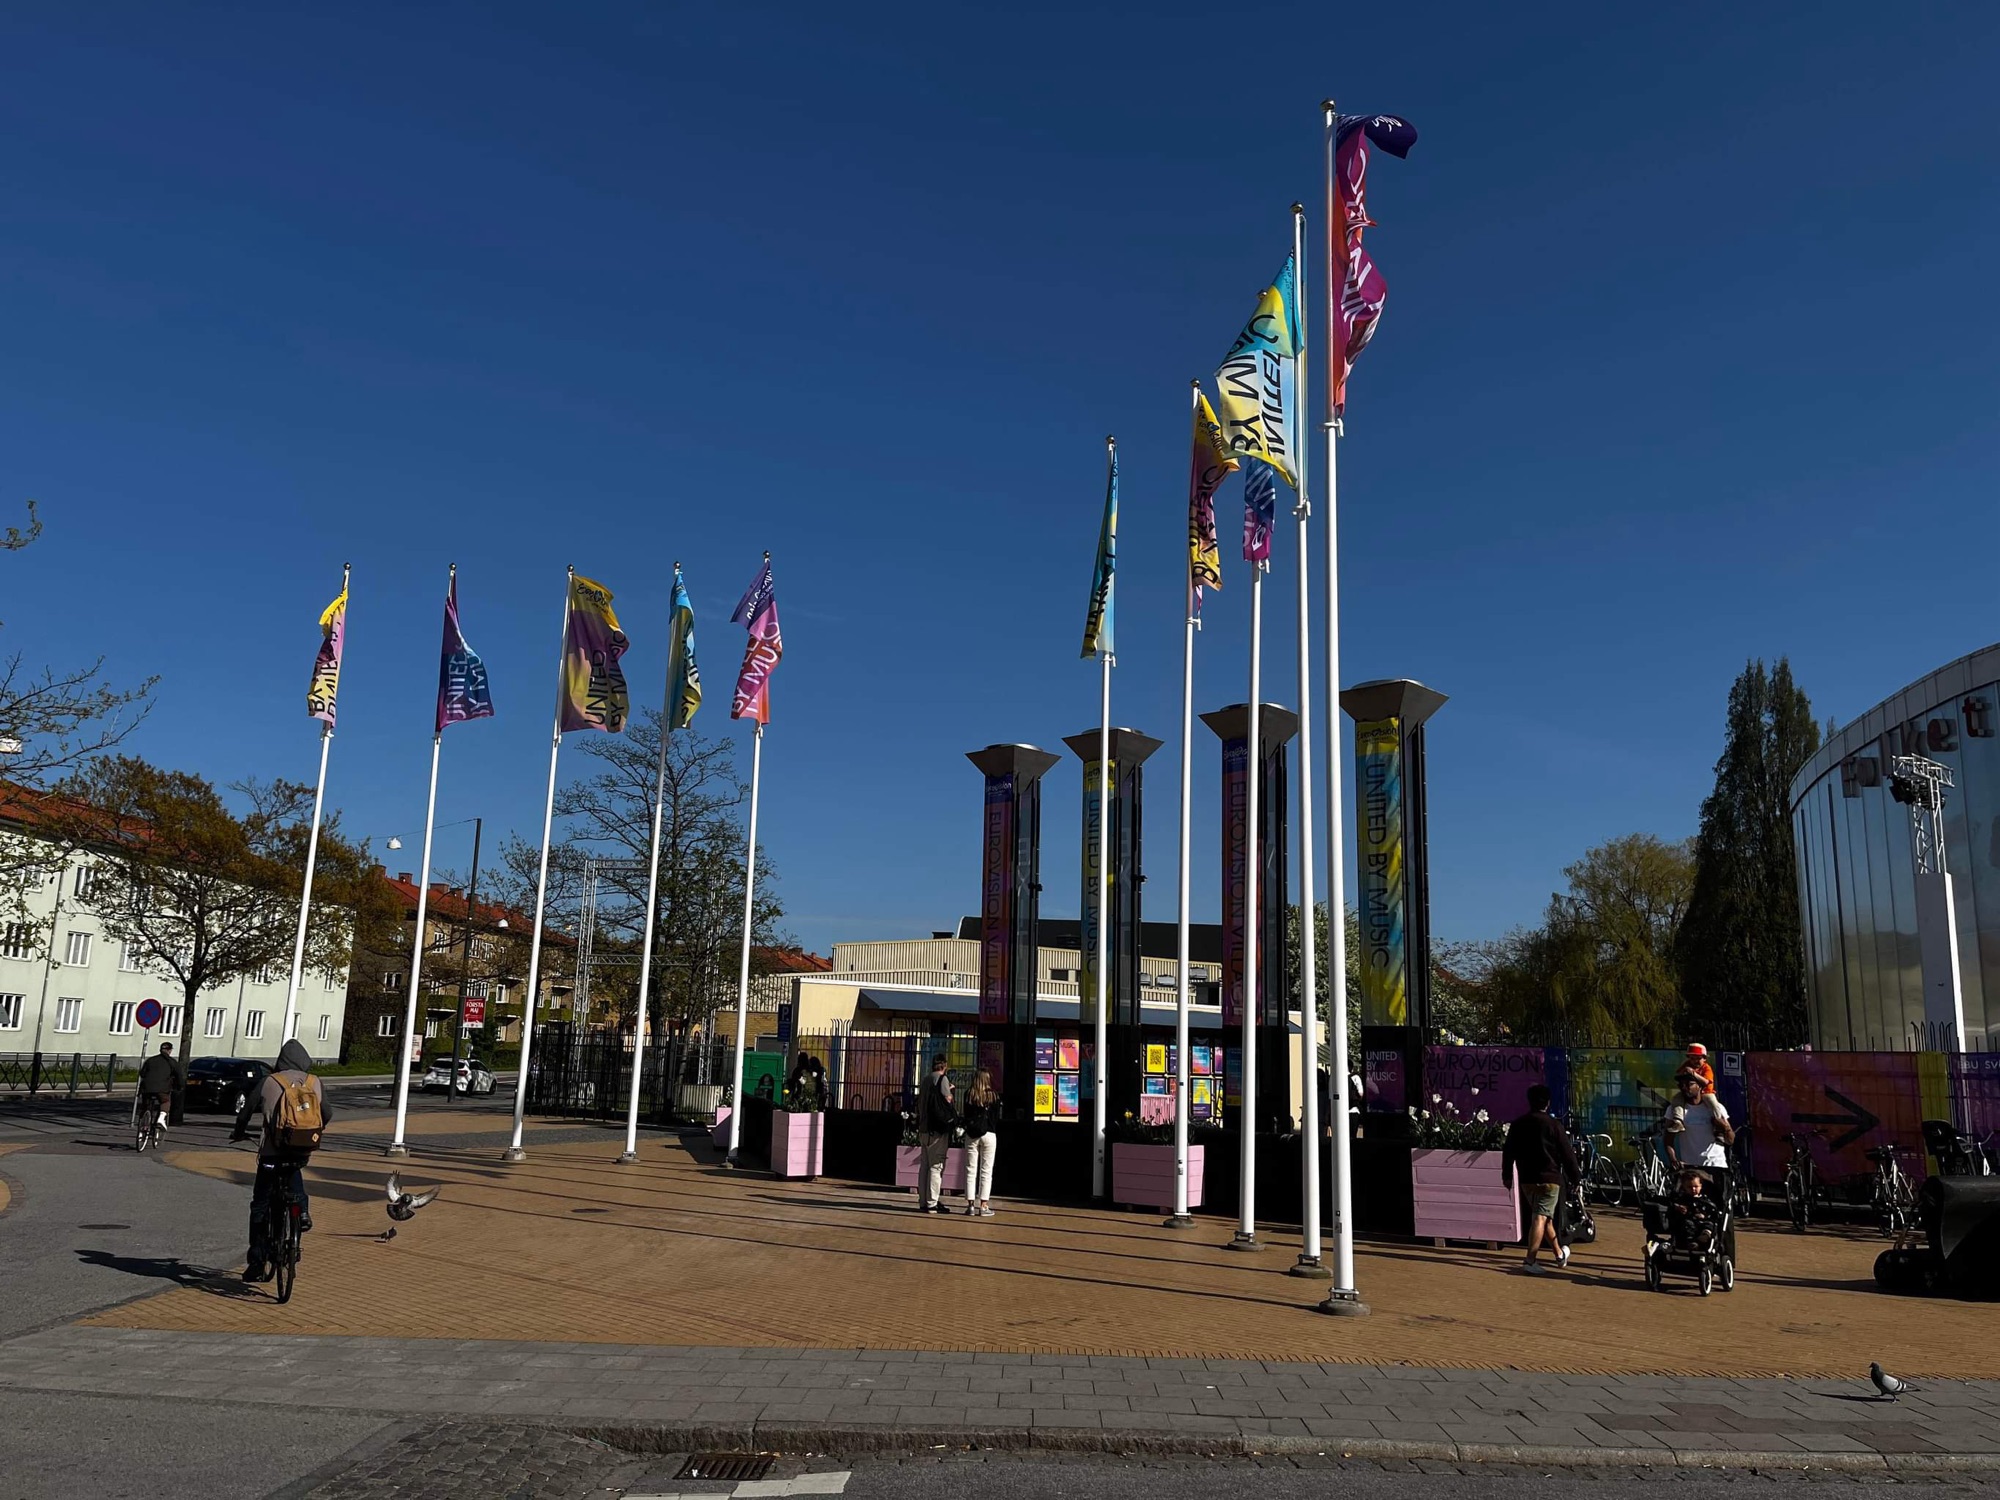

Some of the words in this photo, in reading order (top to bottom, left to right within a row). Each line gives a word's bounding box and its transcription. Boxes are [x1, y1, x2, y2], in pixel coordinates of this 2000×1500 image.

[584, 650, 608, 725] UNITED
[1366, 763, 1387, 843] UNITED
[986, 811, 1001, 930] EUROVISION
[1230, 780, 1247, 917] EUROVISION
[1367, 851, 1388, 880] BY
[1367, 892, 1390, 969] MUSIC
[984, 935, 1000, 1017] VILLAGE
[1365, 1051, 1398, 1062] UNITED
[1365, 1062, 1377, 1071] BY
[1366, 1071, 1398, 1082] MUSIC
[1428, 1054, 1539, 1073] EUROVISION
[1428, 1072, 1498, 1092] VILLAGE
